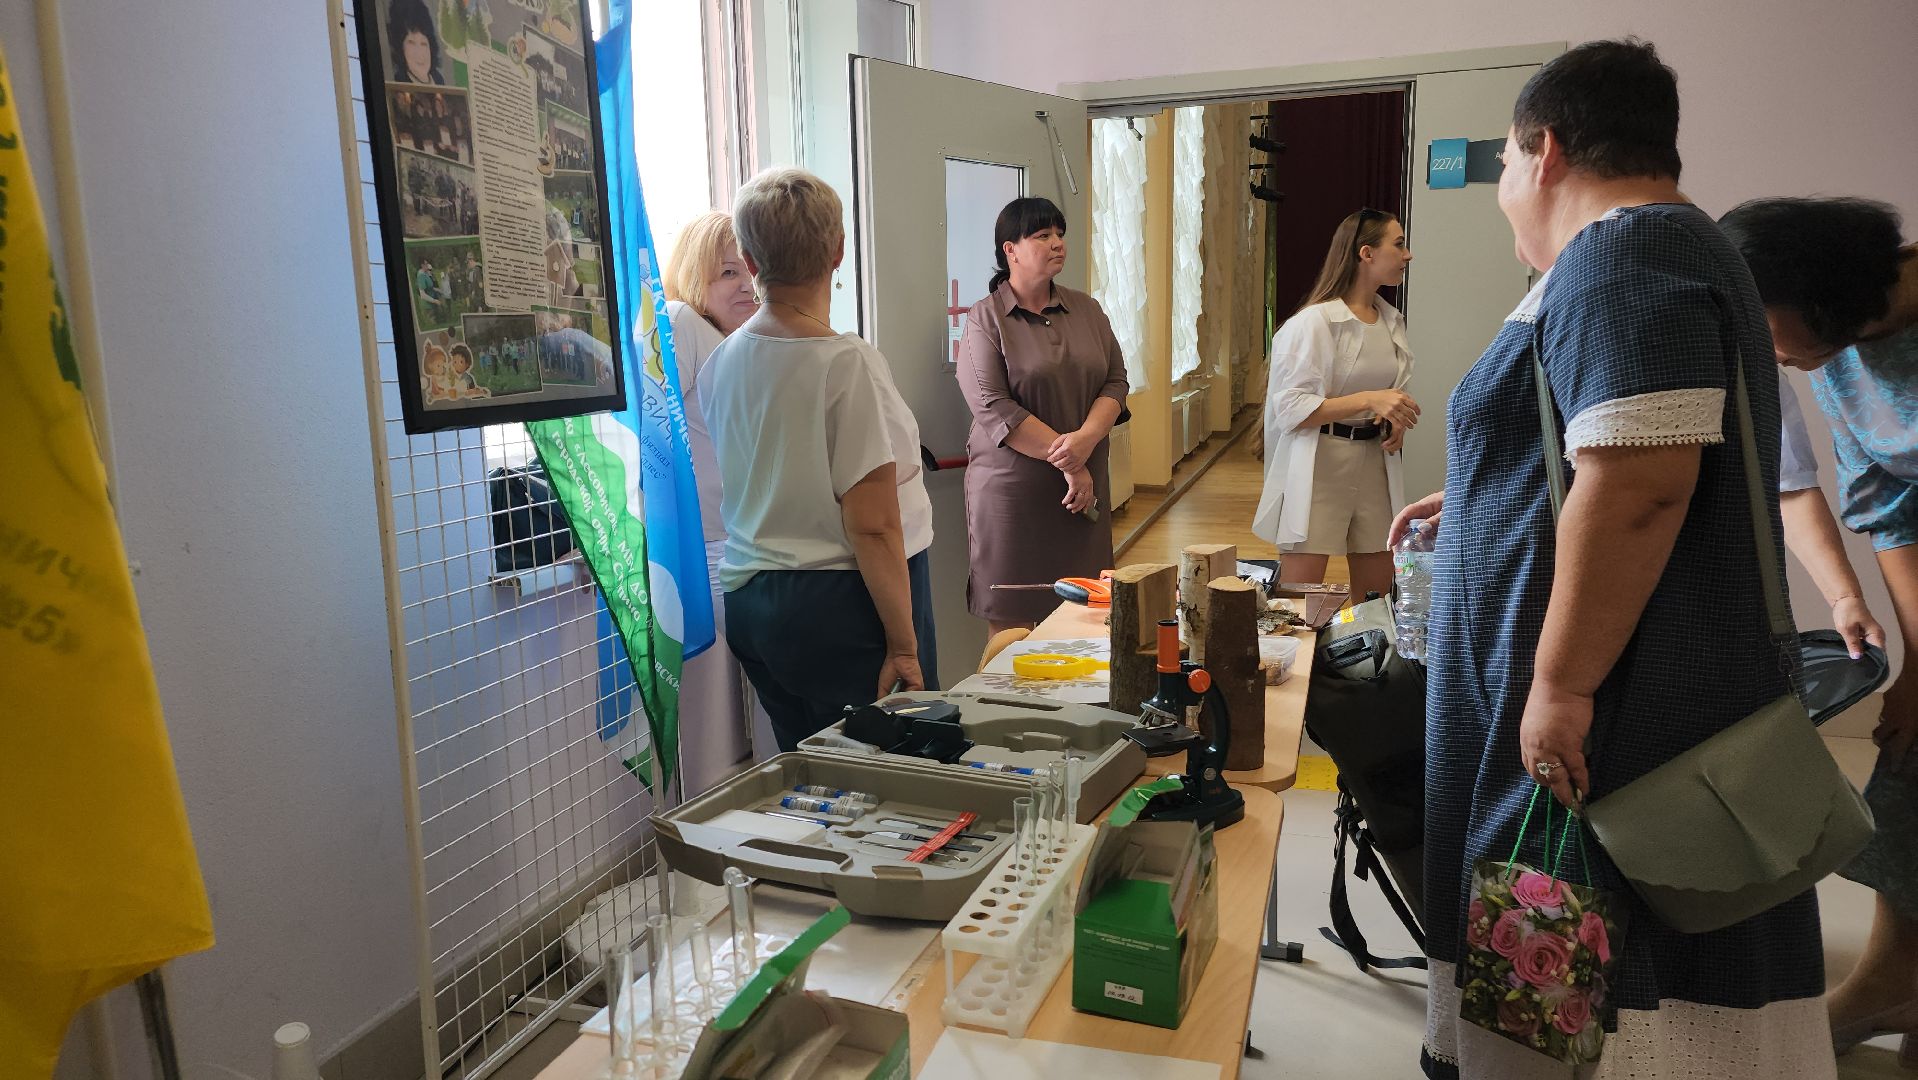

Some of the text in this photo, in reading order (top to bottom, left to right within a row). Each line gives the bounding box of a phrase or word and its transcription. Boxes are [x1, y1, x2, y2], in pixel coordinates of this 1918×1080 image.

[1432, 157, 1463, 171] 227/1
[551, 432, 594, 514] городской
[591, 518, 611, 558] округ
[617, 540, 635, 572] МБУ
[629, 582, 648, 605] ДО
